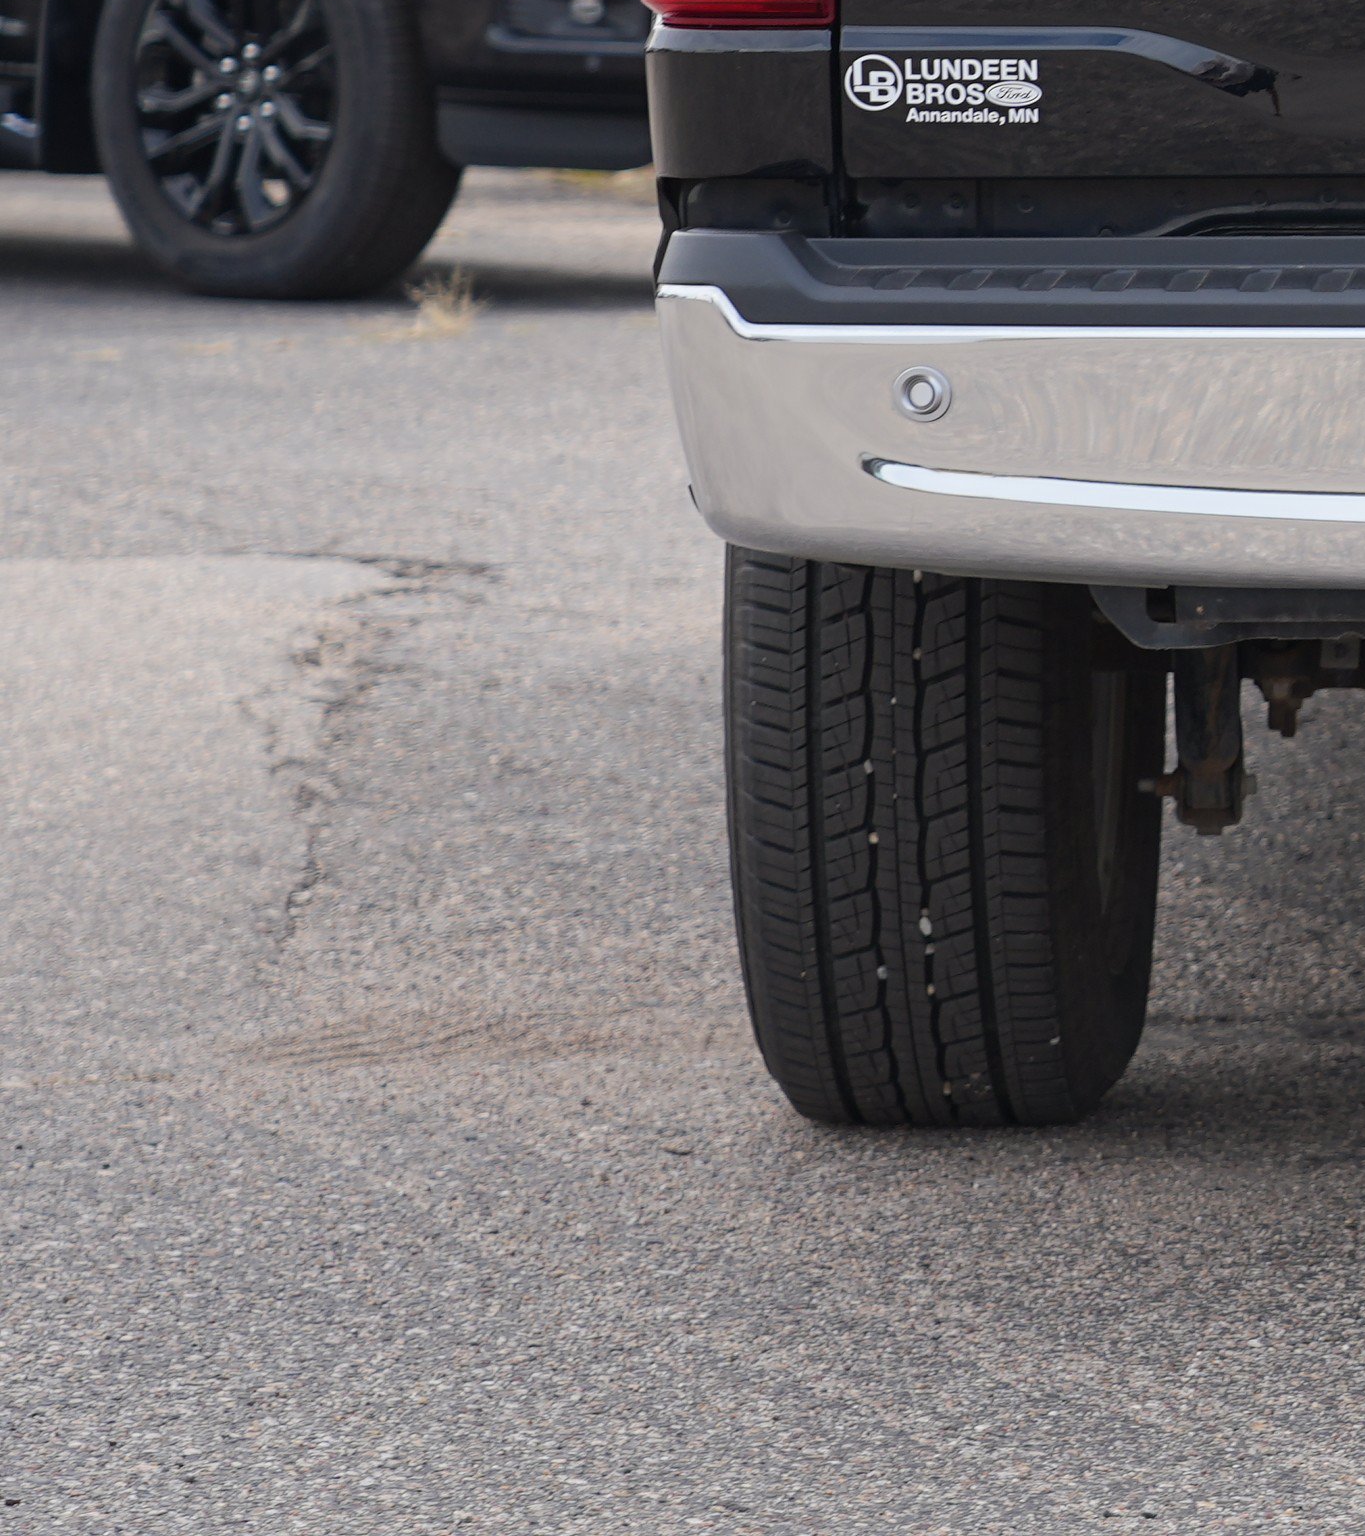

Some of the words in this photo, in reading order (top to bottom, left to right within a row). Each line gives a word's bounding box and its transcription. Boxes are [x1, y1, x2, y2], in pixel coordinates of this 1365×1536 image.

[904, 59, 1038, 81] LUNDEEN
[905, 83, 986, 105] BROS
[905, 108, 1006, 126] Annandale,
[1007, 108, 1039, 124] MN
